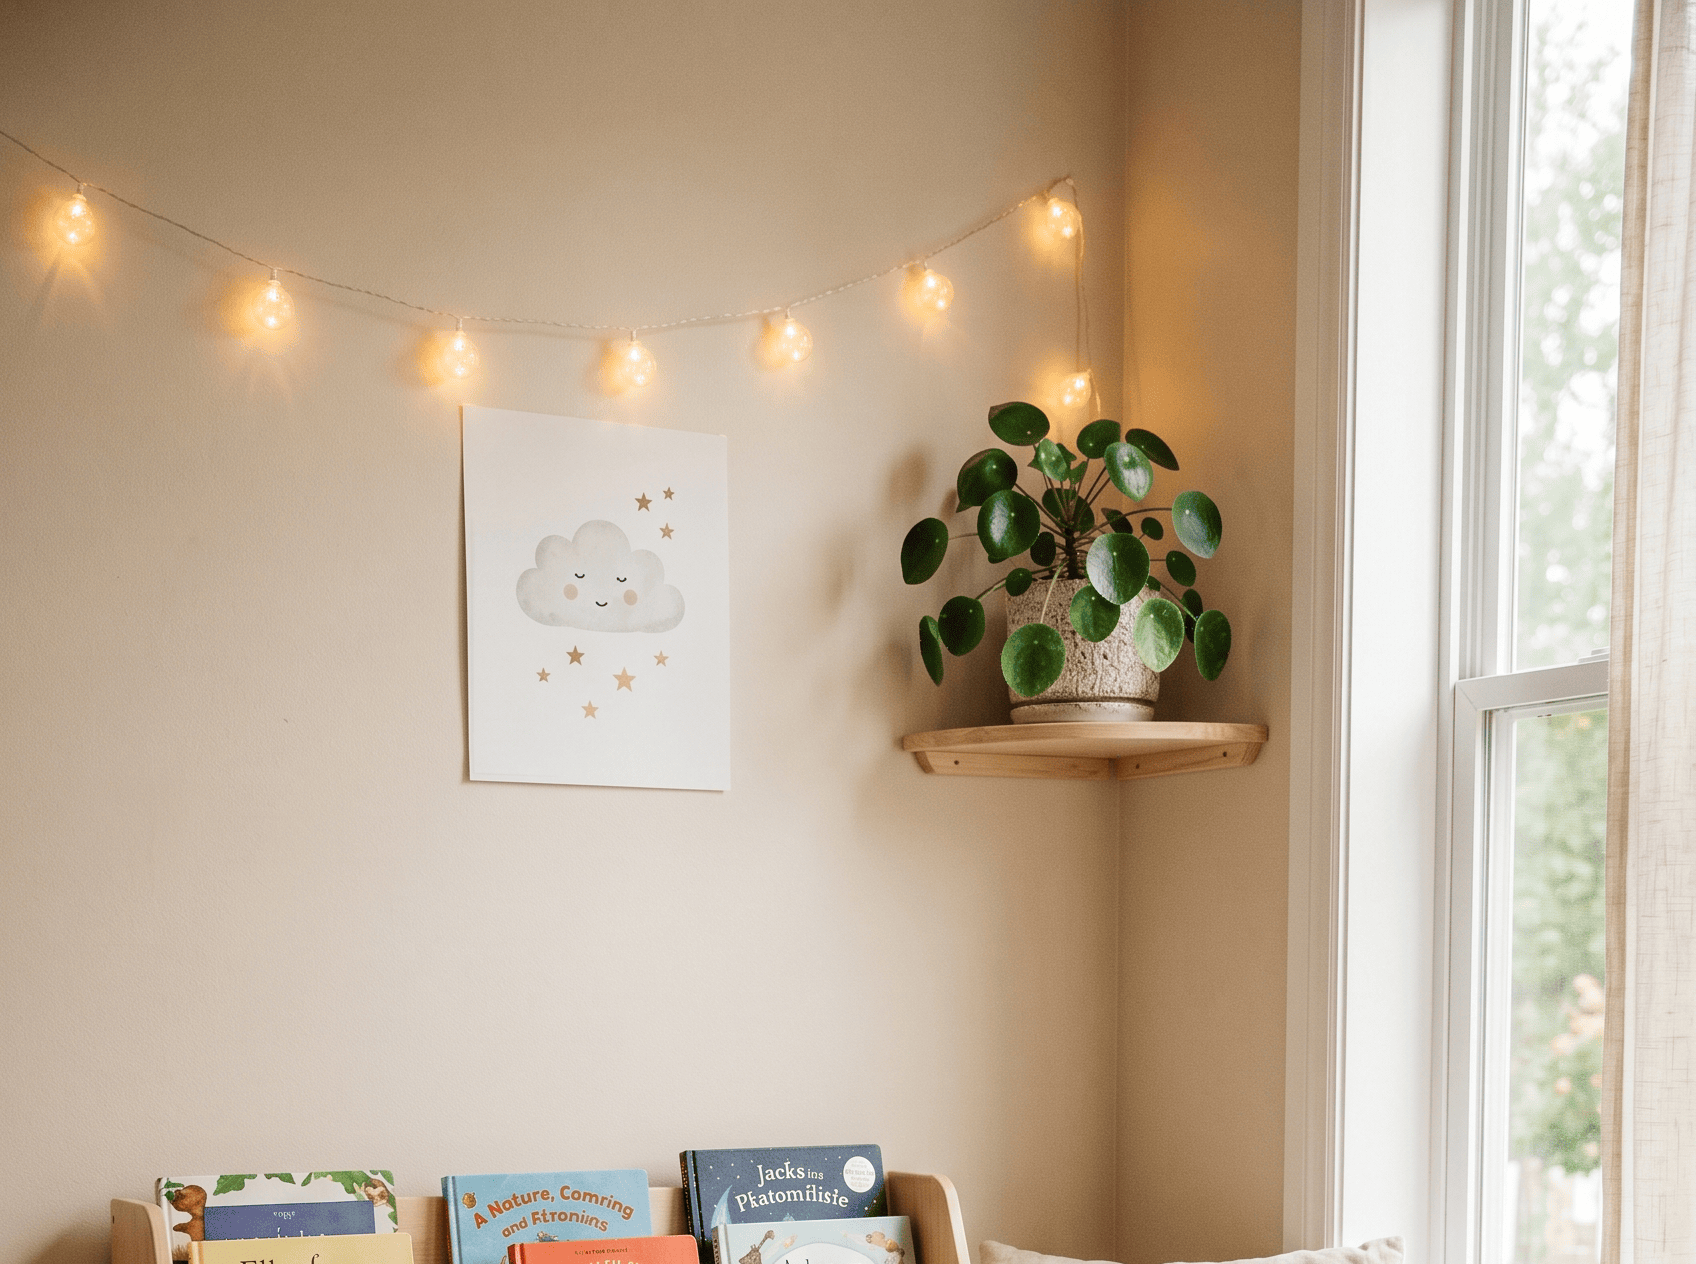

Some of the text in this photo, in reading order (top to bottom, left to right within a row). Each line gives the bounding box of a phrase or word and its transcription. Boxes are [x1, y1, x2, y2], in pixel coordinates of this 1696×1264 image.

[757, 1161, 806, 1188] Jacks
[807, 1168, 824, 1180] ins
[473, 1185, 635, 1230] A Nature, Comring
[501, 1215, 529, 1239] and
